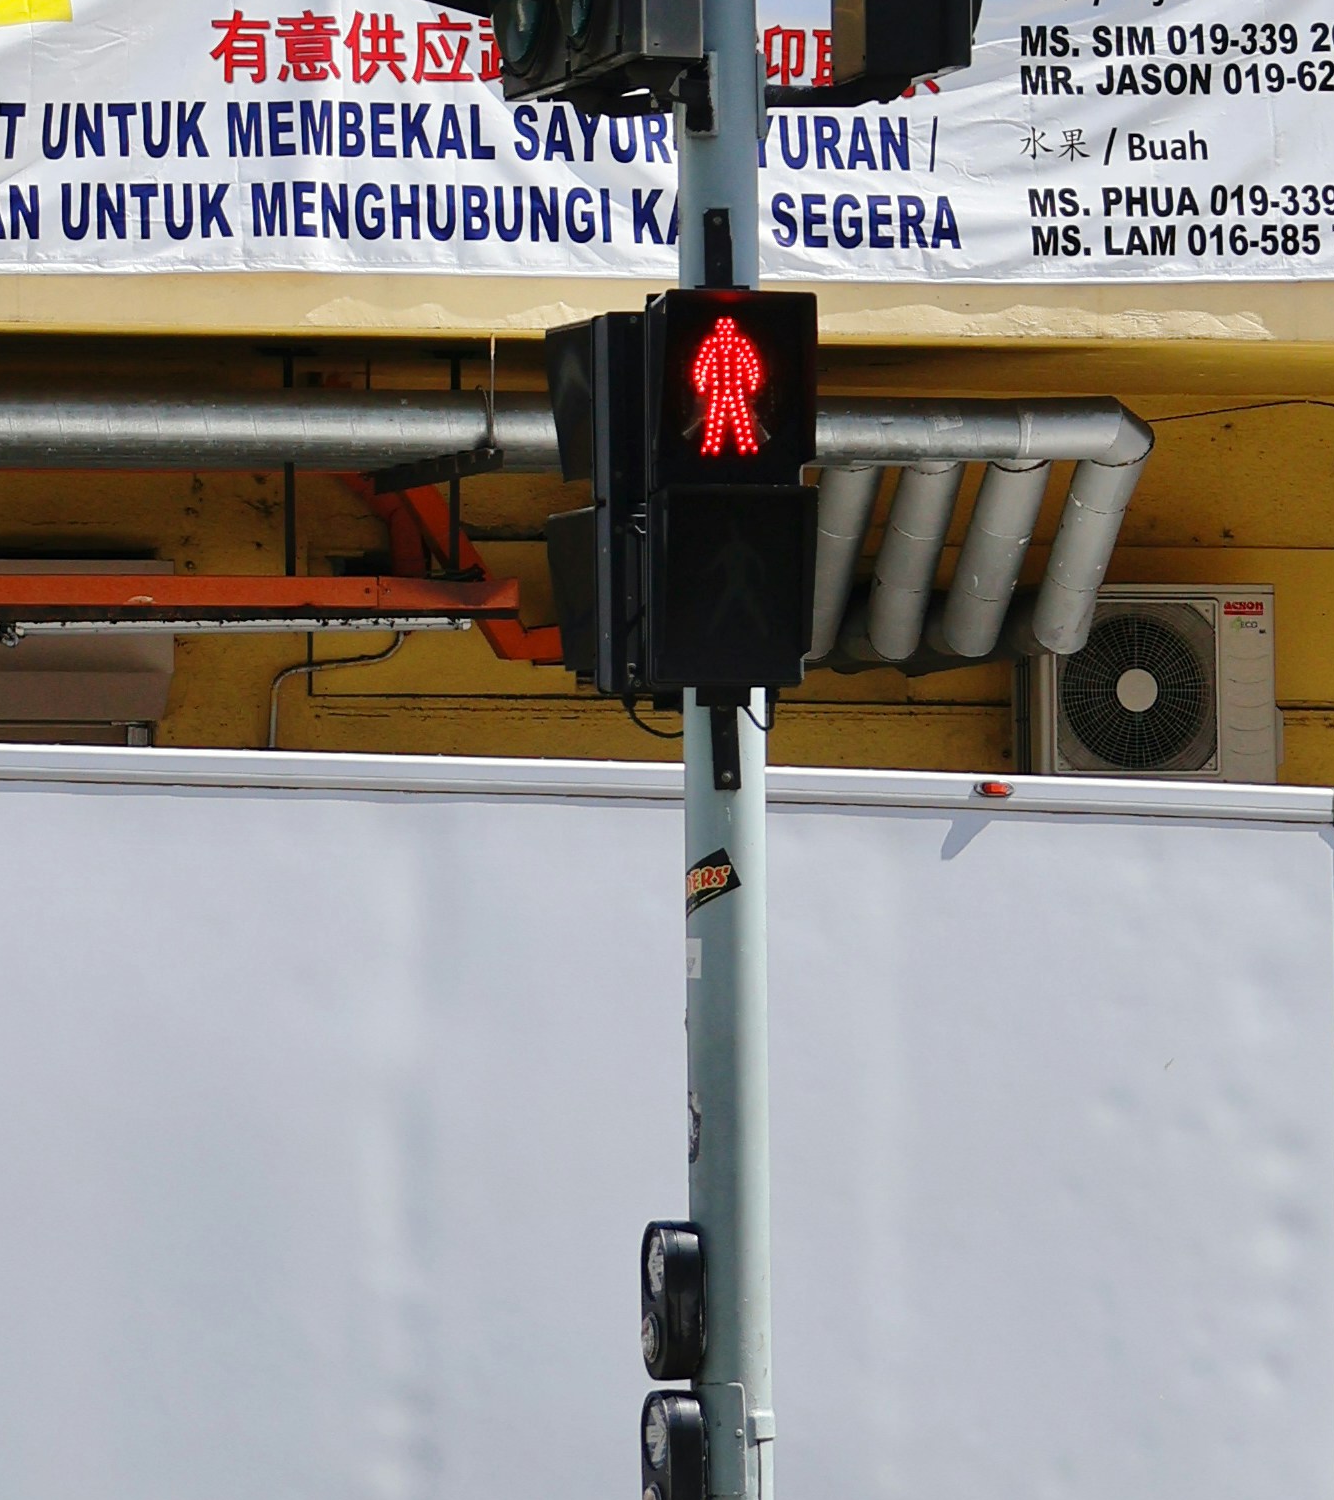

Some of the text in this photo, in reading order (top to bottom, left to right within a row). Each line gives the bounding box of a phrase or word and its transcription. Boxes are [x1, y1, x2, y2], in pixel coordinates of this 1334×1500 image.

[1020, 25, 1080, 58] MS.
[1091, 25, 1156, 58] SIM
[1167, 23, 1298, 56] 019-339
[1020, 65, 1084, 96] MR.
[1095, 63, 1212, 96] JASON
[41, 100, 210, 160] UNTUK
[226, 99, 496, 160] MEMBEKAL
[1020, 126, 1091, 162] 水果
[1127, 130, 1208, 161] Buah
[61, 182, 234, 241] UNTUK
[251, 180, 612, 244] MENGHUBUNGI
[771, 192, 962, 250] SEGERA
[1028, 187, 1091, 217] MS.
[1101, 186, 1200, 218] PHUA
[1031, 224, 1091, 257] MS.
[1104, 224, 1176, 256] LAM
[1187, 223, 1321, 257] 016-585
